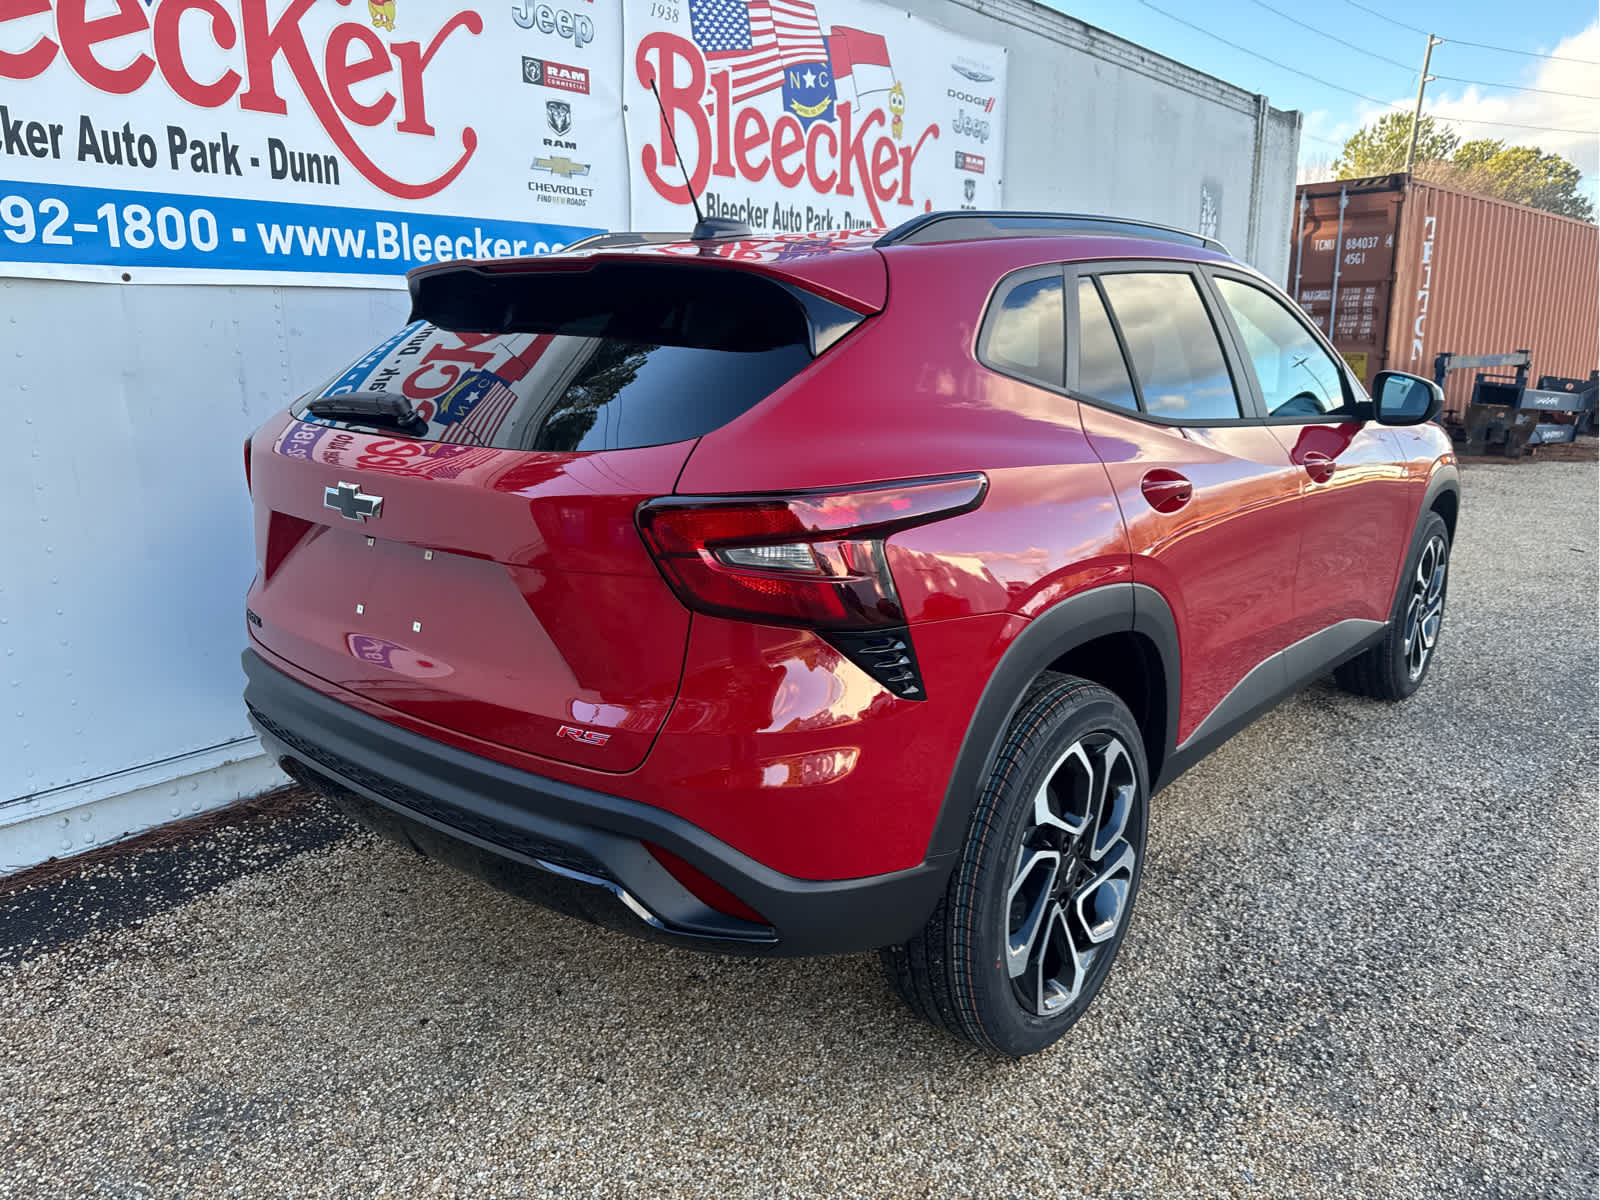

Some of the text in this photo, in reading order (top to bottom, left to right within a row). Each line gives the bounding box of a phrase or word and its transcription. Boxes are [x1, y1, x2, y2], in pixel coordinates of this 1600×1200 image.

[650, 2, 680, 24] 1938
[511, 0, 595, 48] Jeep
[547, 66, 585, 81] RAM
[790, 71, 801, 89] N
[818, 71, 829, 88] C
[635, 31, 940, 229] Bleecker
[952, 108, 991, 144] Jeep
[0, 105, 63, 159] ker
[78, 115, 157, 169] Auto
[167, 125, 242, 177] Park
[269, 137, 340, 186] Dunn
[543, 138, 577, 150] RAM
[528, 181, 594, 197] CHEVROLET
[537, 193, 552, 203] FIND
[566, 197, 587, 206] ROADS
[706, 192, 770, 229] Bleecker
[772, 201, 802, 232] Auto
[806, 206, 835, 231] Park
[556, 725, 612, 746] RS
